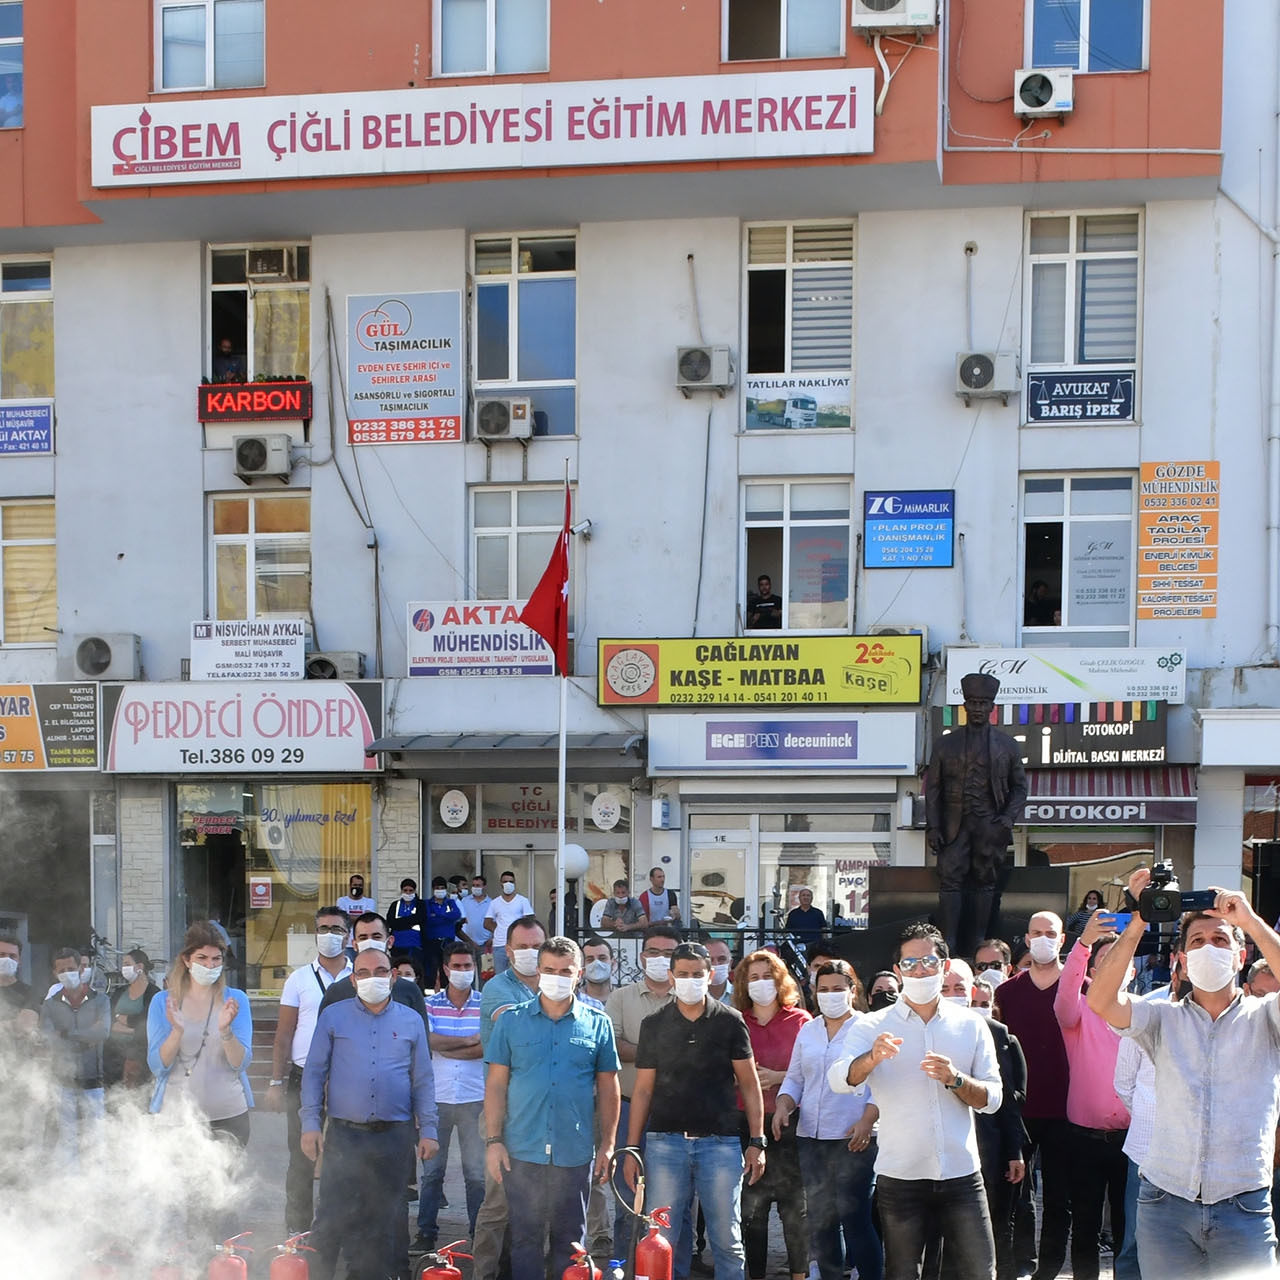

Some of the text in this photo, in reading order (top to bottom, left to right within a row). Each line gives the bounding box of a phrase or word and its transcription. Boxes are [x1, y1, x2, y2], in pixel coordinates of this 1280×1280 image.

[267, 84, 859, 162] ÇİĞLİ BELEDİYESİ EĞİTİM MERKEZİ
[365, 319, 404, 338] GÜL
[374, 338, 452, 353] TAŞIMACILIK
[357, 362, 451, 373] EVDEN EVE ve
[412, 374, 437, 383] ARASI
[746, 377, 850, 389] TATLILAR NAKLİYAT
[403, 391, 412, 399] ve
[1052, 382, 1111, 396] AVUKAT
[206, 389, 302, 413] KARBON
[379, 402, 429, 413] TAŞIMACILIK
[1040, 401, 1120, 419] BARIŞ İPEK
[353, 418, 456, 431] 0232 386 31 76
[10, 430, 48, 441] AKTAY
[353, 429, 456, 442] 0532 579 44 72
[1155, 464, 1205, 478] GÖZDE
[1142, 478, 1218, 494] MÜHENDİSLİK
[867, 496, 903, 515] ZG
[1144, 497, 1216, 507] 0532 336 02 41
[1158, 515, 1200, 525] ARAÇ
[878, 523, 947, 532] PLAN PROJE
[1147, 525, 1211, 534] TADİLAT
[877, 534, 946, 543] DANIŞMANLIK
[1152, 535, 1205, 545] PROJESİ
[1144, 550, 1212, 560] ENERJİ KİMLİK
[1159, 562, 1199, 571] BELGESİ
[1173, 578, 1204, 588] TESİSAT
[441, 605, 532, 629] AKTA
[215, 621, 304, 637] NİSVİCİHAN AYKAL
[221, 638, 297, 647] SERBEST MUHASEBECİ
[433, 630, 546, 653] MÜHENDİSLİK
[234, 650, 284, 659] MALİ MÜŞAVİR
[695, 641, 800, 665] ÇAĞLAYAN
[855, 642, 885, 664] 20
[438, 668, 459, 676] GSM:
[461, 668, 481, 676] 0545
[670, 668, 826, 690] KAŞE MATBAA
[670, 691, 829, 704] 0232 329 14 14 0541 201 40 11
[124, 692, 357, 746] PERDECİ ÖNDER
[1083, 720, 1134, 737] FOTOKOPİ
[711, 732, 853, 749] EGEPEN deceuninck
[3, 750, 16, 763] 57
[20, 750, 35, 762] 75
[179, 747, 305, 765] Tel.386 09 29
[1053, 746, 1165, 764] DİJİTAL BASKI MERKEZİ
[511, 799, 551, 814] ÇİĞLİ
[1023, 802, 1147, 820] FOTOKOPİ
[260, 807, 281, 823] 30.
[333, 807, 358, 826] özel
